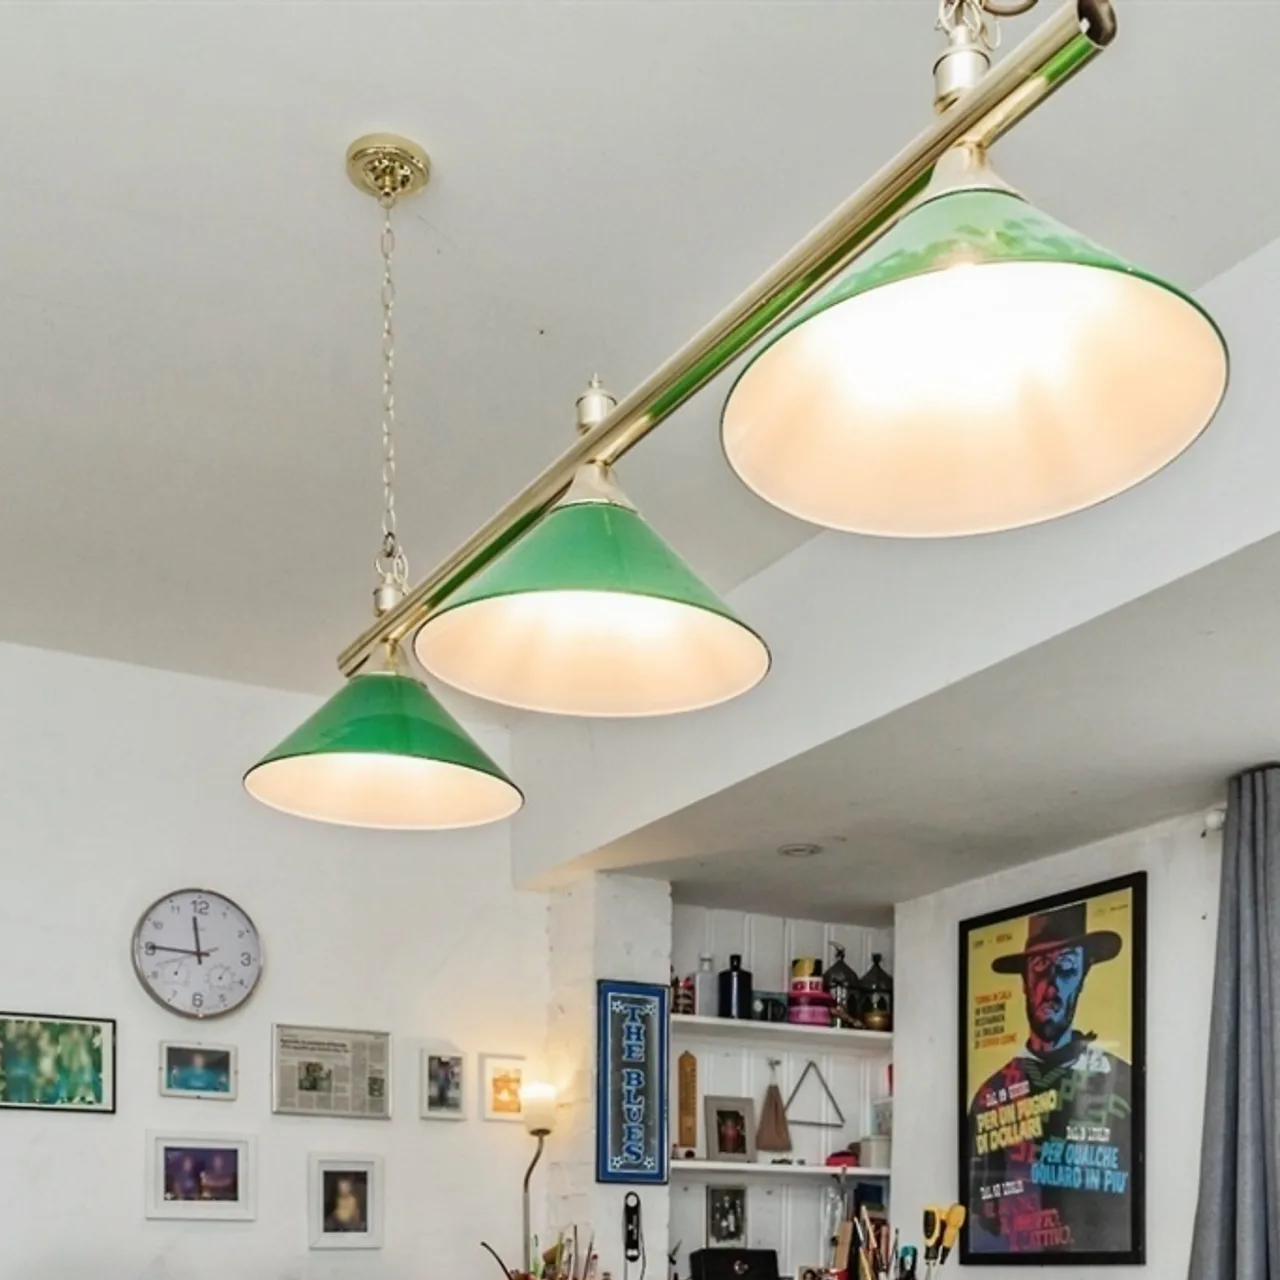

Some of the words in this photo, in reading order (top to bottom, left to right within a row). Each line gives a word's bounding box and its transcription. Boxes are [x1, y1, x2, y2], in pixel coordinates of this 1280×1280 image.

[170, 904, 181, 914] 11
[190, 899, 210, 916] 12
[240, 952, 252, 967] 3
[192, 992, 204, 1008] 6
[623, 1005, 645, 1062] THE
[623, 1069, 645, 1163] BLUES
[976, 1109, 999, 1133] PER
[999, 1102, 1016, 1126] UN
[1016, 1088, 1058, 1121] PUGNO
[976, 1133, 989, 1156] DI
[989, 1115, 1044, 1152] DOLLARI
[1041, 1141, 1065, 1164] PER
[1065, 1143, 1119, 1170] QUALCHE
[1031, 1162, 1082, 1189] DOLLARO
[1084, 1168, 1101, 1191] IN
